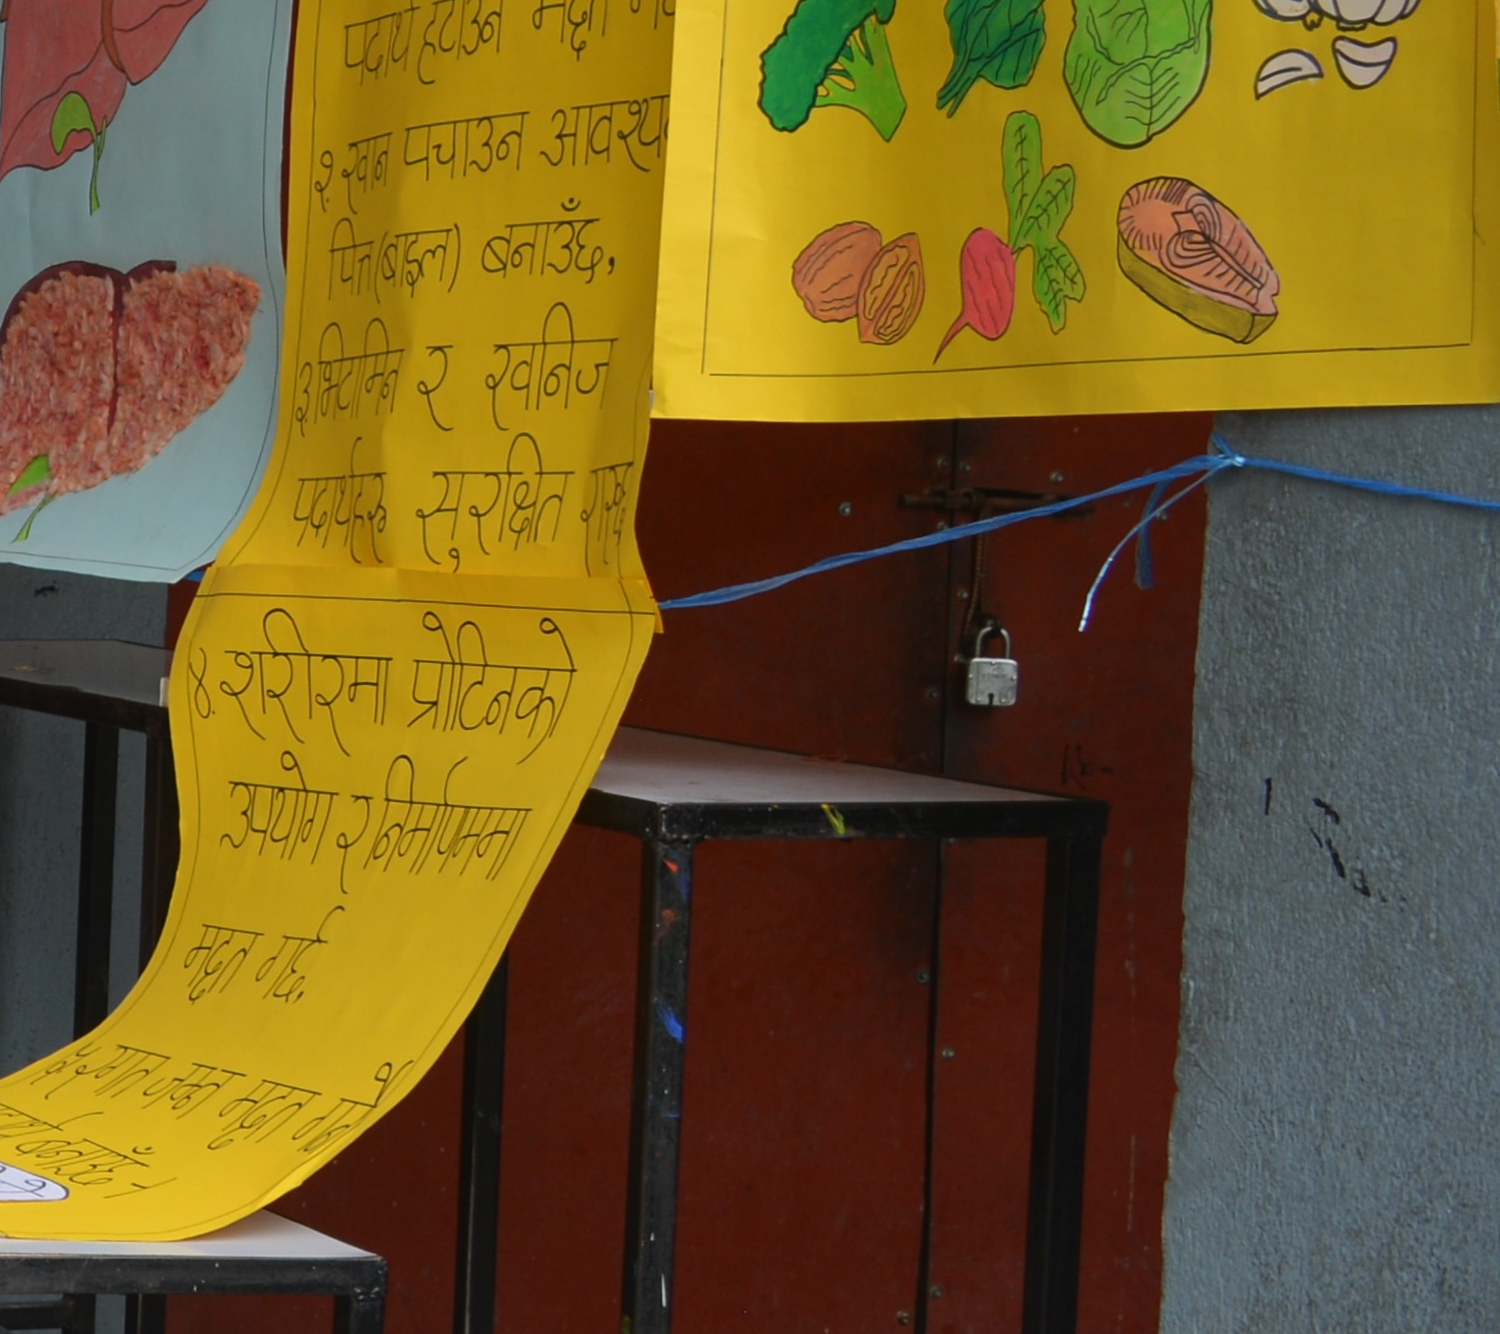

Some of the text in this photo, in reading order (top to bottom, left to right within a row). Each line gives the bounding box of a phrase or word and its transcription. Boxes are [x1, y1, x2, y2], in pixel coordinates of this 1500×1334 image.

[402, 110, 531, 181] पचाउन
[539, 94, 670, 172] आवश्य
[416, 343, 455, 432] र
[335, 793, 375, 895] र
